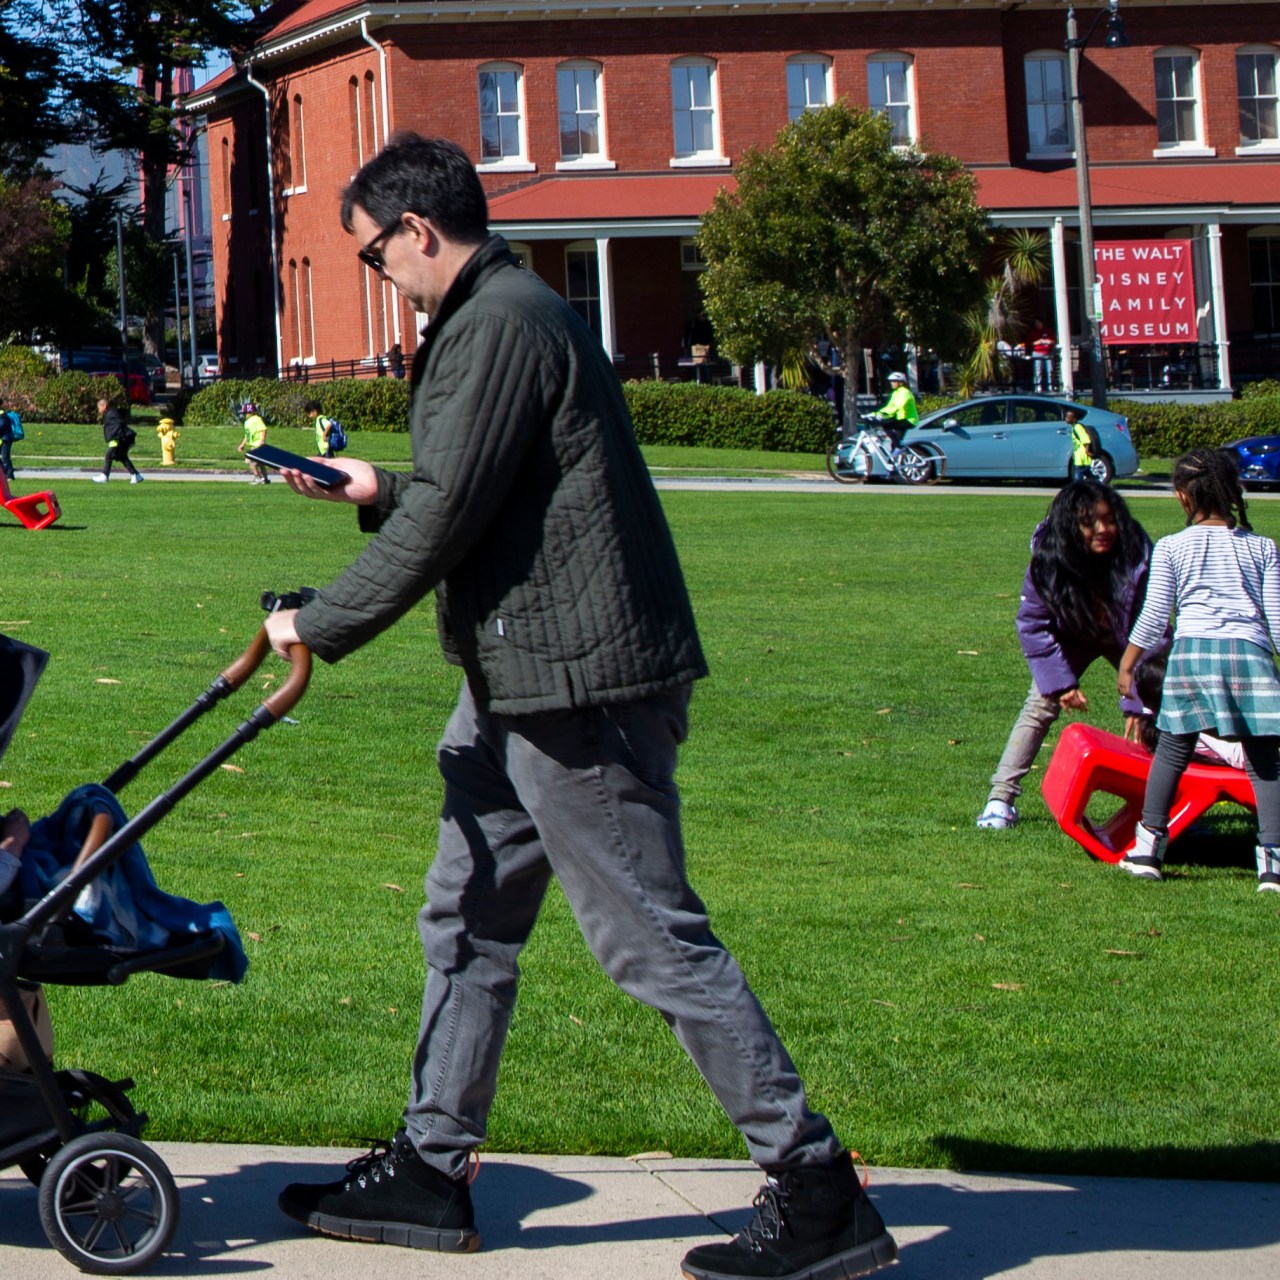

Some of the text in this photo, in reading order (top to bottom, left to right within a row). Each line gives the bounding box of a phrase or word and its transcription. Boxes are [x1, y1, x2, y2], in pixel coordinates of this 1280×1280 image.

[1132, 246, 1183, 260] WALT
[1106, 297, 1186, 312] AMILY
[1101, 322, 1189, 337] MUSEUM
